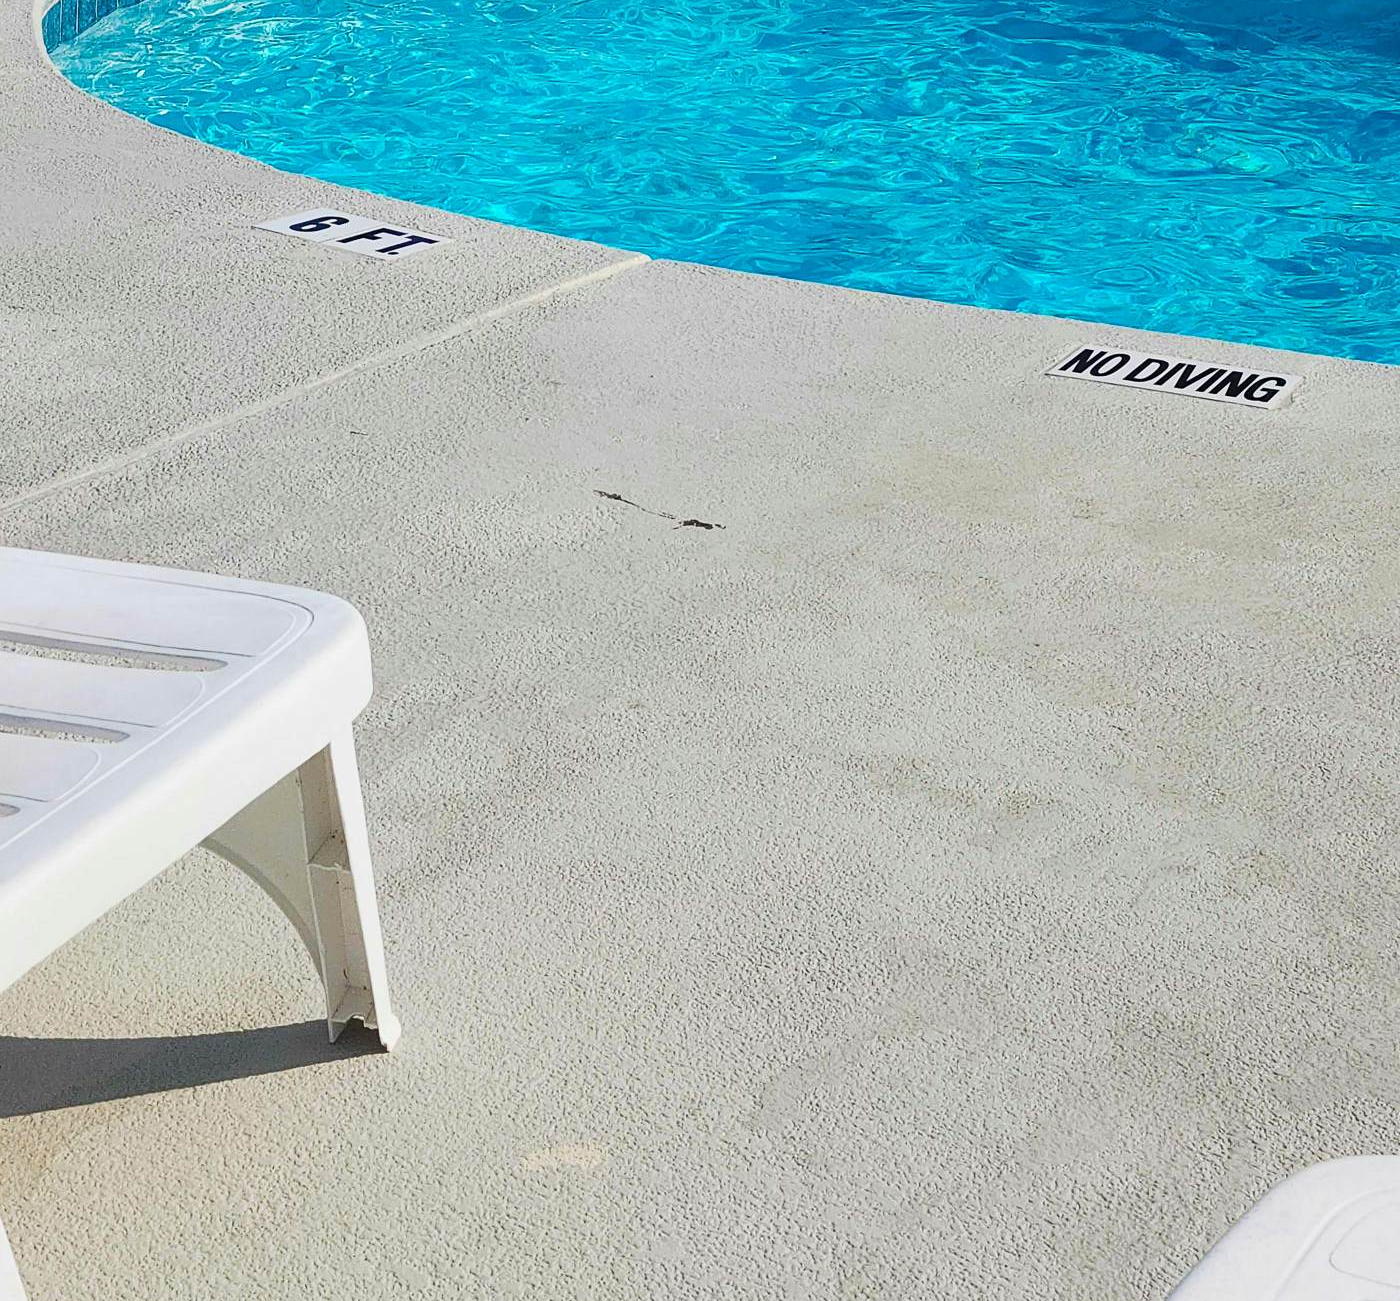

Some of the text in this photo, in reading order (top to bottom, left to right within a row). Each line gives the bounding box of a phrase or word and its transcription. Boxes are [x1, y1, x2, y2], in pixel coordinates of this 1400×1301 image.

[289, 216, 350, 233] 6
[1058, 348, 1287, 403] NO DIVING
